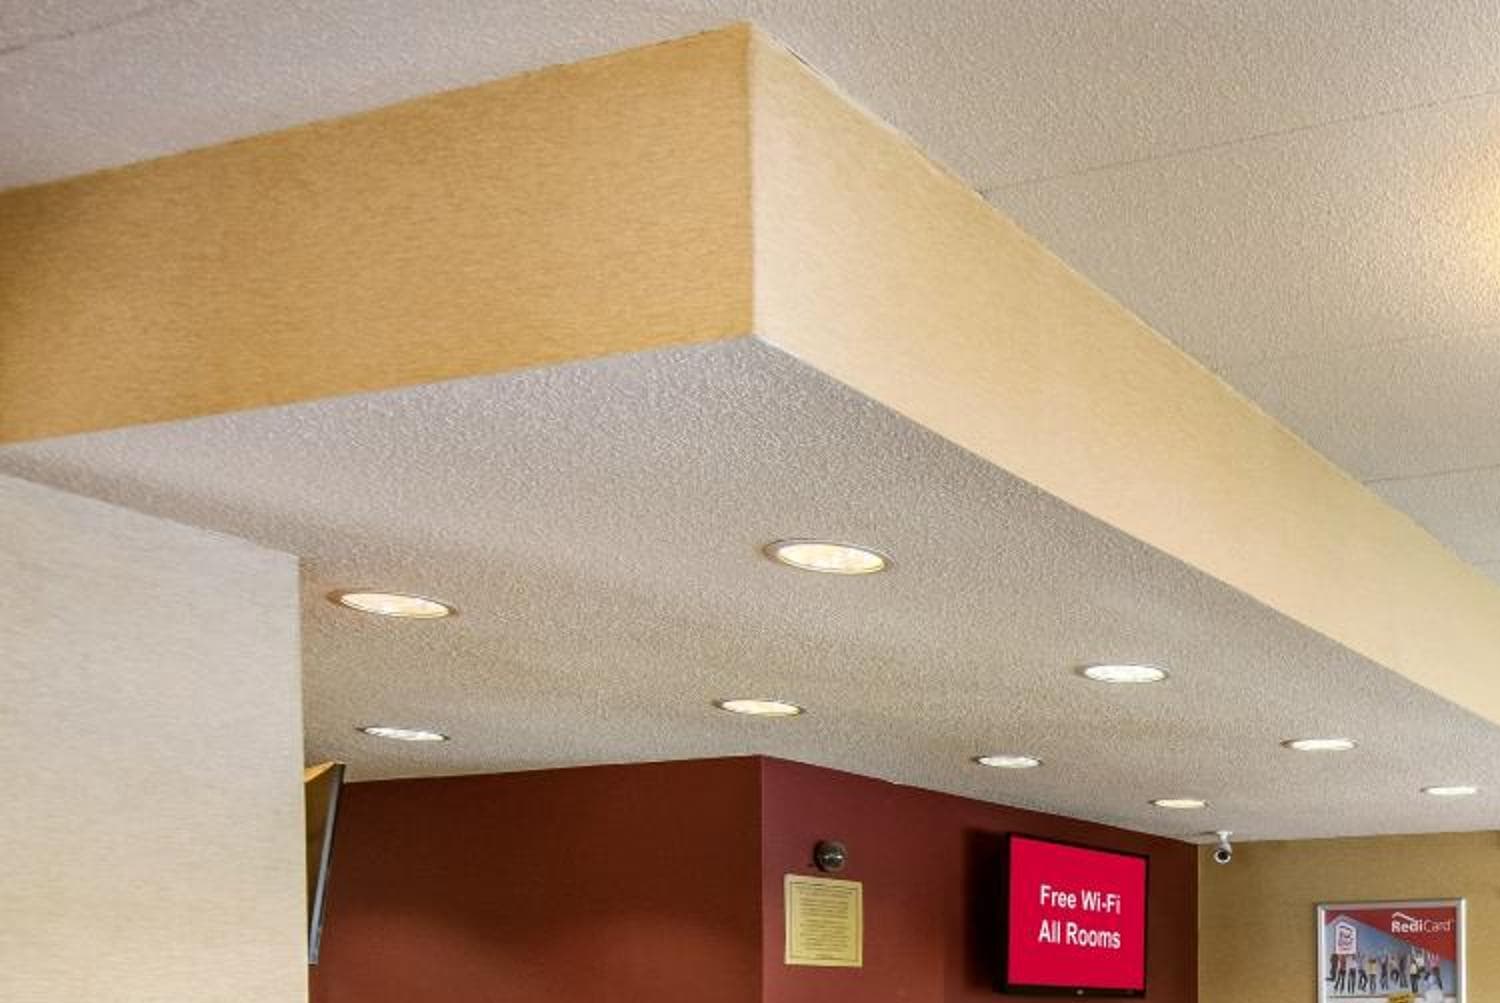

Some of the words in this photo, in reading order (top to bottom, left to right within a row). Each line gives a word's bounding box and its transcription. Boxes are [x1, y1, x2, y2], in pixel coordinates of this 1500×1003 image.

[1040, 884, 1077, 909] Free
[1081, 889, 1121, 914] Wi-Fi
[1038, 920, 1061, 944] All
[1066, 921, 1121, 949] Rooms
